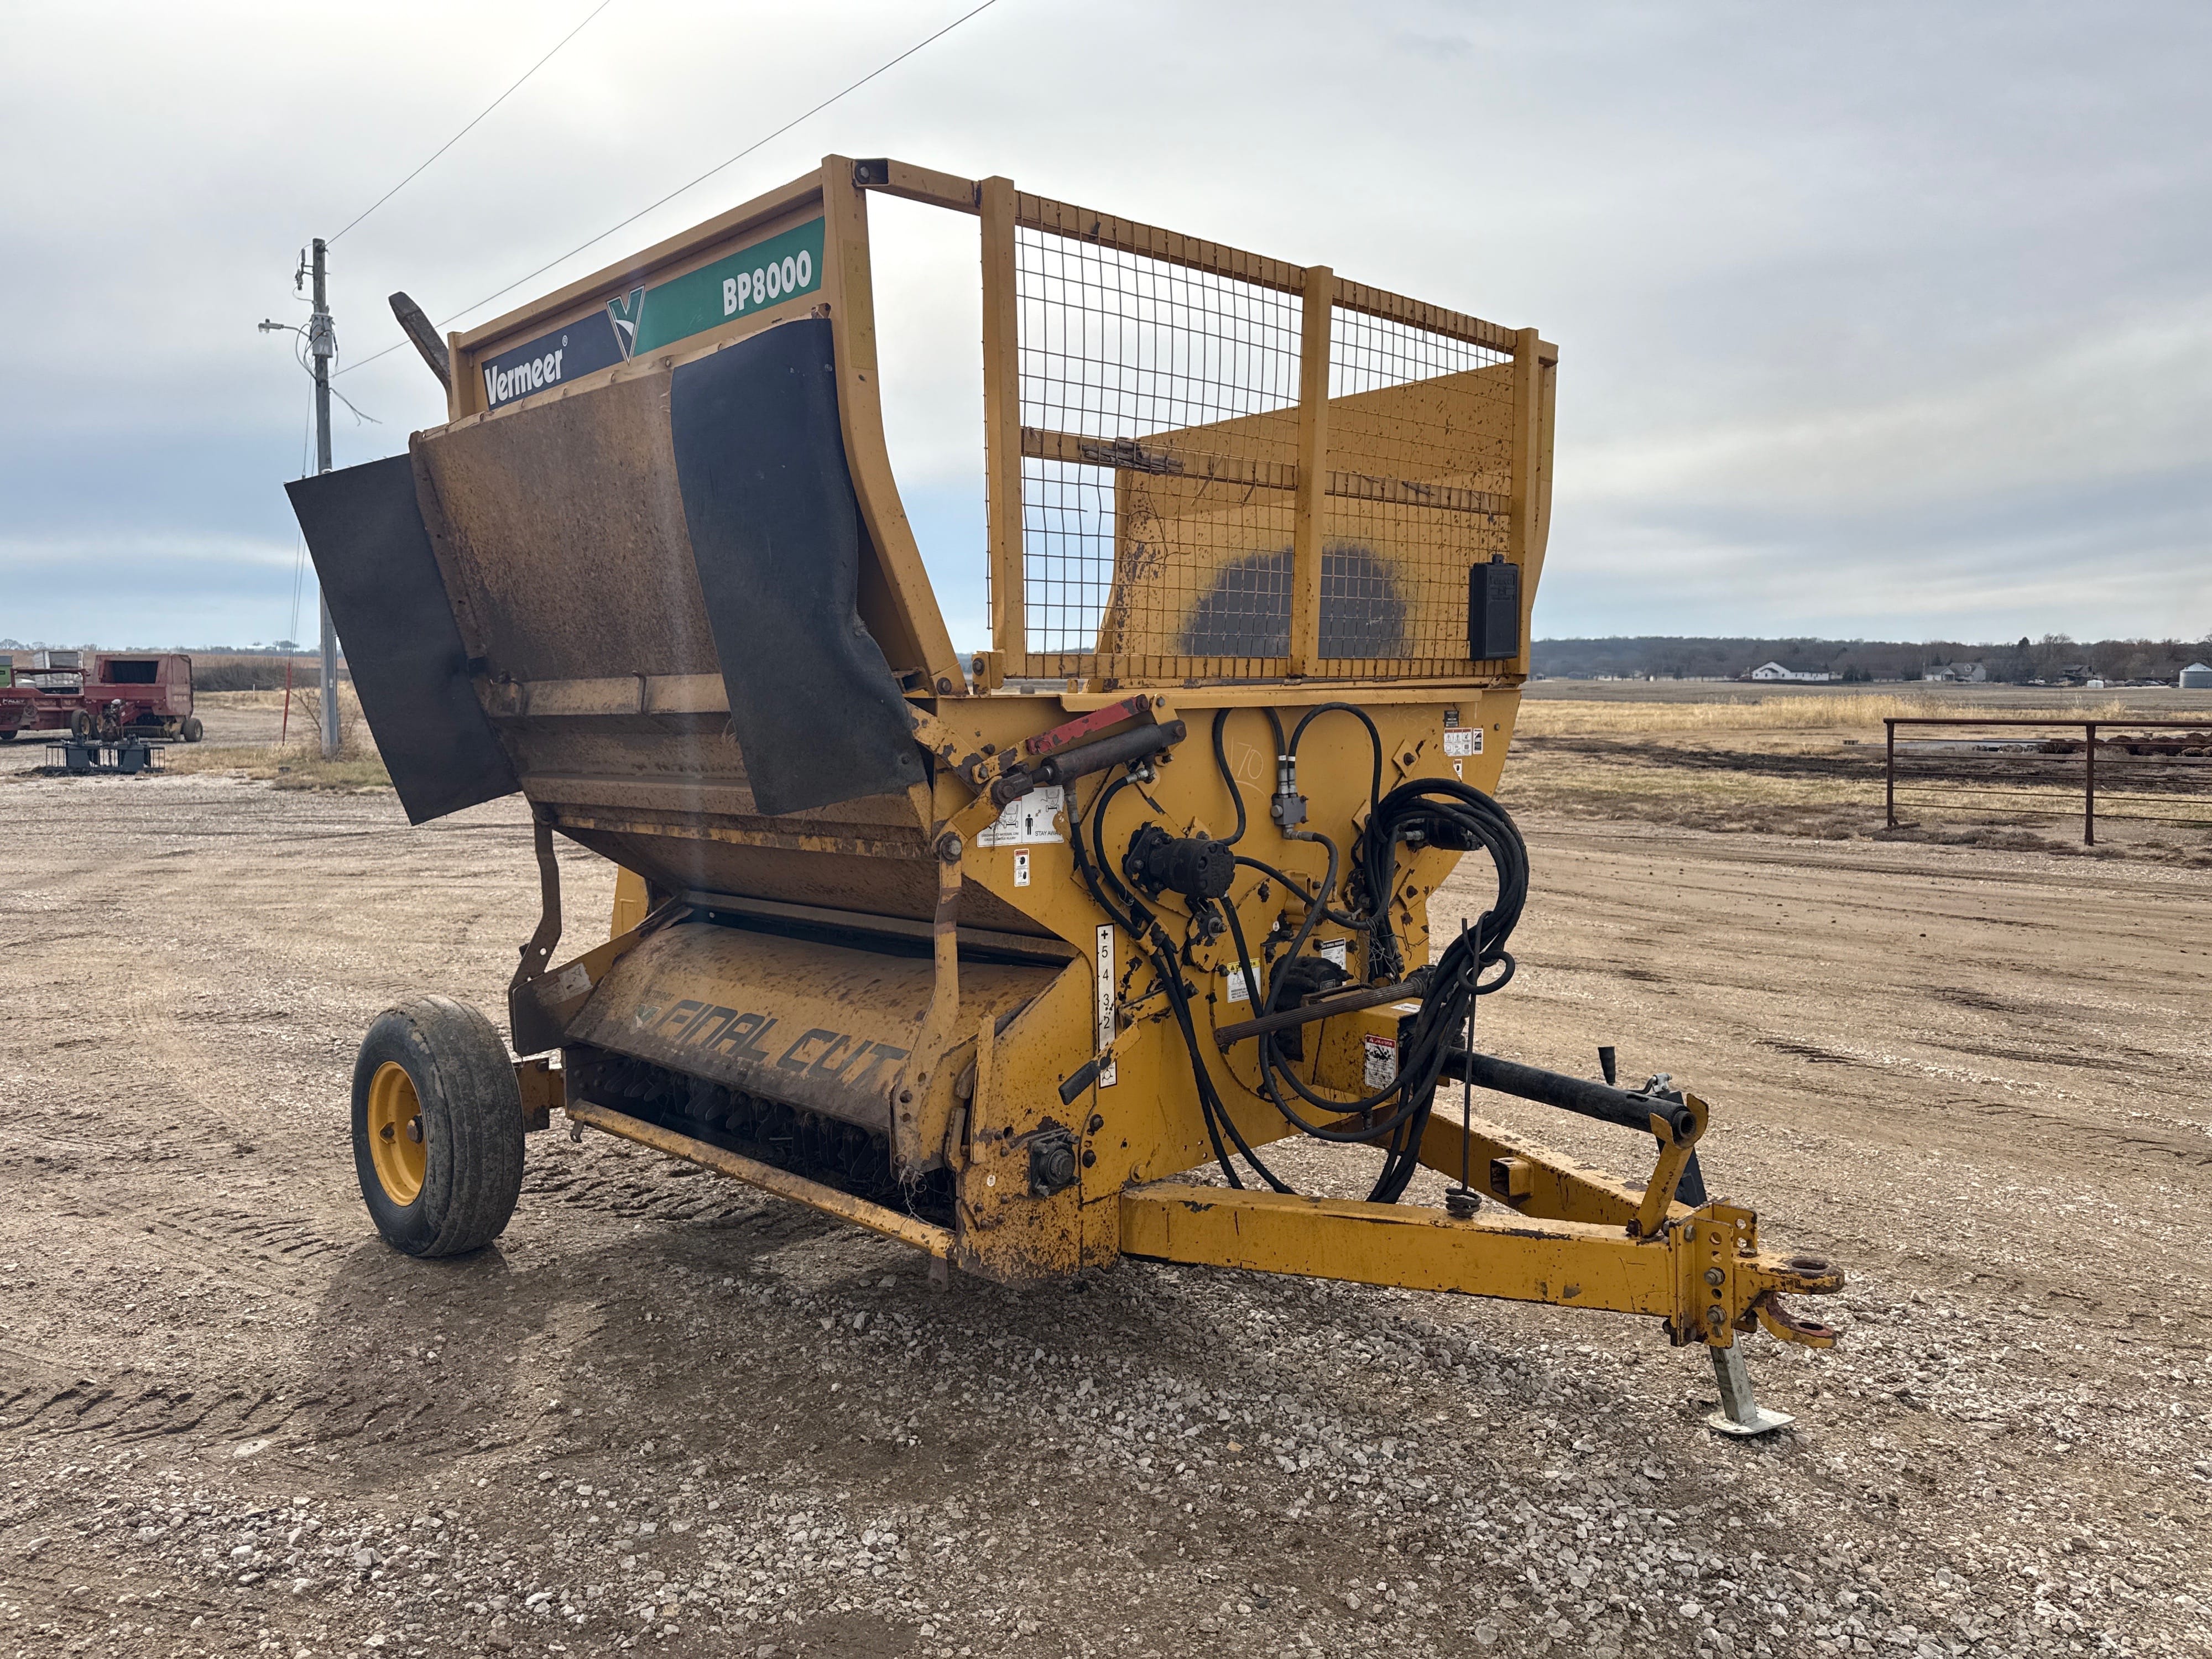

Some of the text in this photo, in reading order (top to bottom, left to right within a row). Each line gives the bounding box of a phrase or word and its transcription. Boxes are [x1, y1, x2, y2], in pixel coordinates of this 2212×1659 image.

[722, 249, 812, 316] BP8000
[1101, 945, 1108, 958] 5
[1102, 968, 1109, 981] 4
[1103, 993, 1110, 1006] 3
[1103, 1016, 1110, 1030] 2
[651, 999, 910, 1089] FINAL CUT
